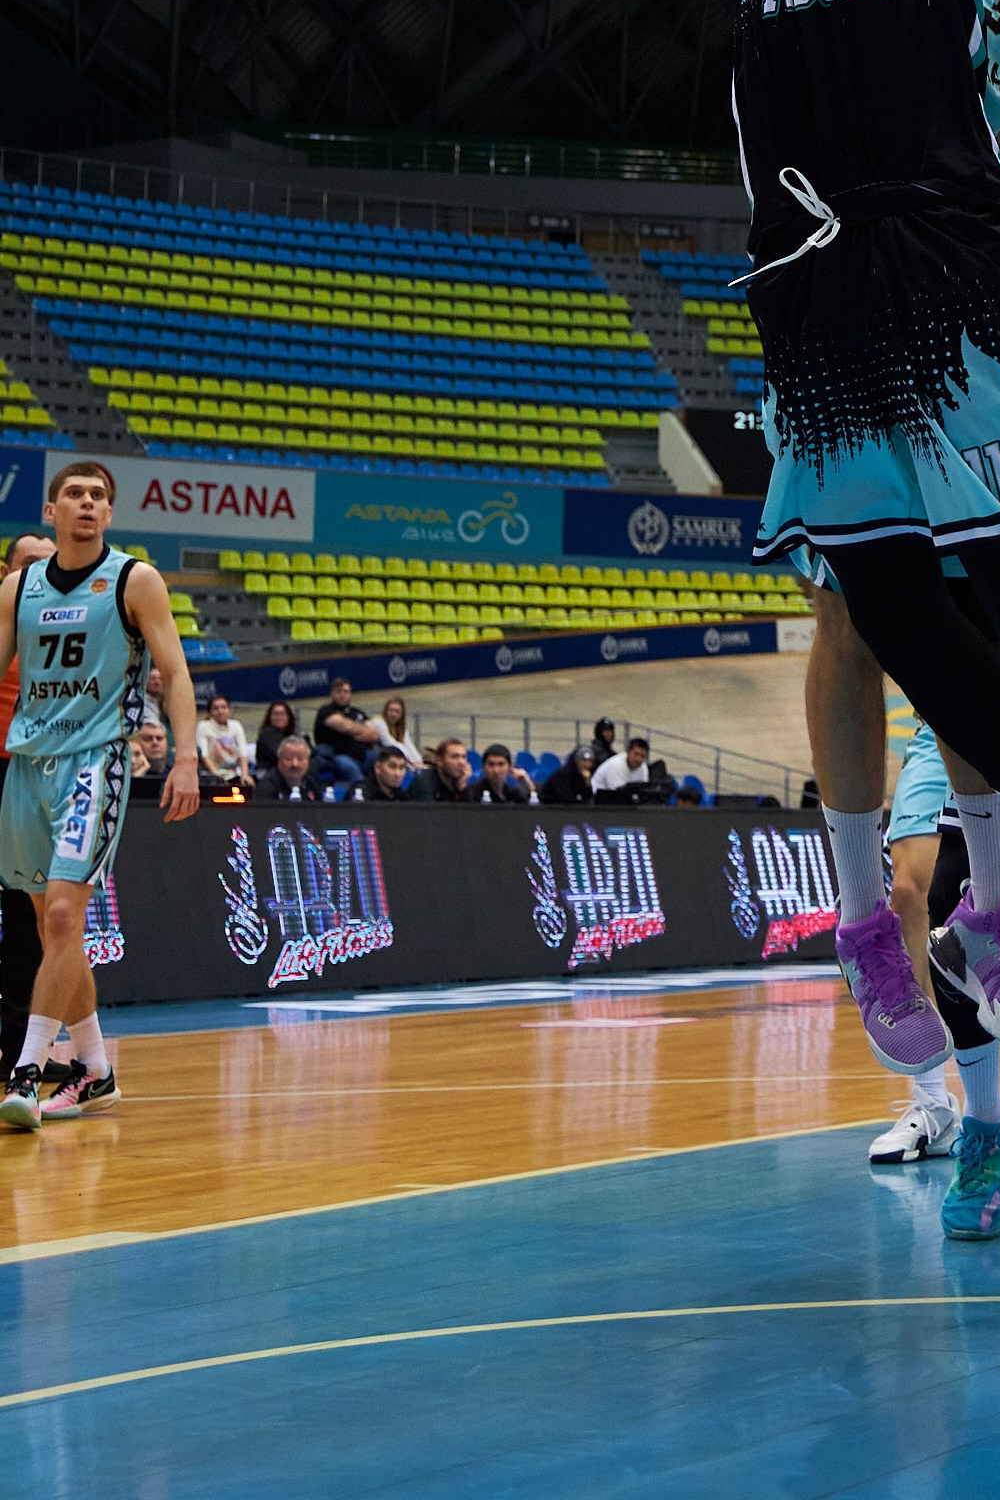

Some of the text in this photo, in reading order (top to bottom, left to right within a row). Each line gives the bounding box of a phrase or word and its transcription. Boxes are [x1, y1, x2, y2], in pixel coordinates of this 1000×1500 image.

[141, 478, 296, 520] ASTANA
[39, 632, 87, 670] 76
[28, 676, 100, 701] ASTANA
